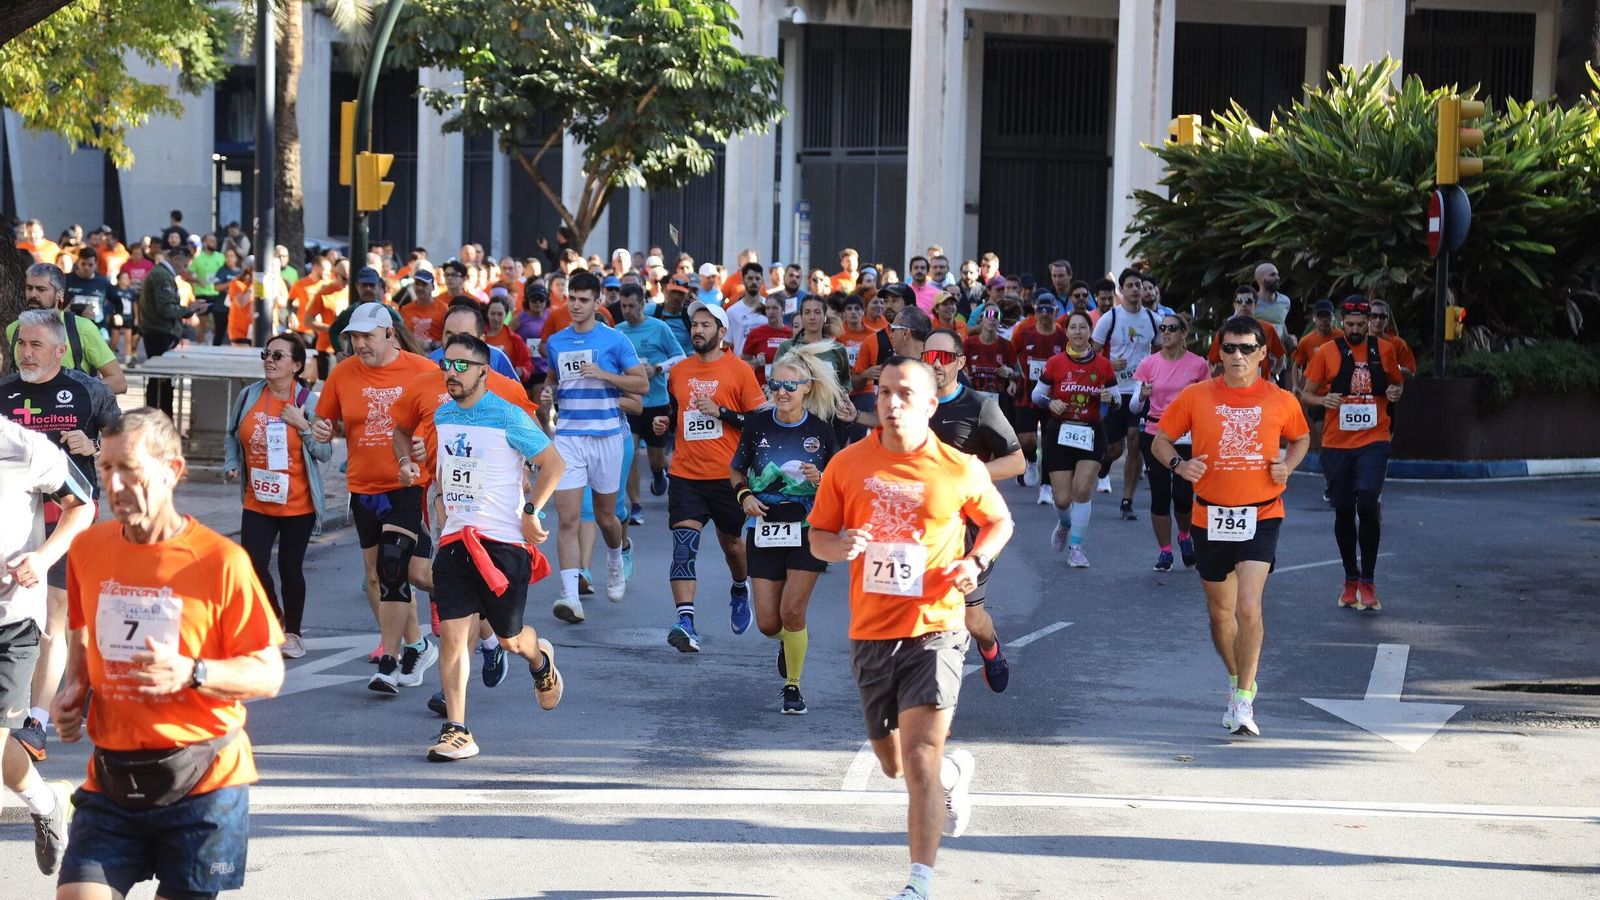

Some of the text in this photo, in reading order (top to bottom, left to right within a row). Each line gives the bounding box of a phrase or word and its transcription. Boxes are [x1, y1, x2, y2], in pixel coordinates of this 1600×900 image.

[1345, 413, 1371, 423] 500
[688, 419, 715, 432] 250
[1064, 431, 1087, 442] 364
[453, 469, 471, 484] 51
[254, 480, 281, 494] 563
[1214, 517, 1247, 530] 794
[761, 524, 791, 537] 871
[872, 560, 912, 579] 713
[123, 620, 139, 641] 7
